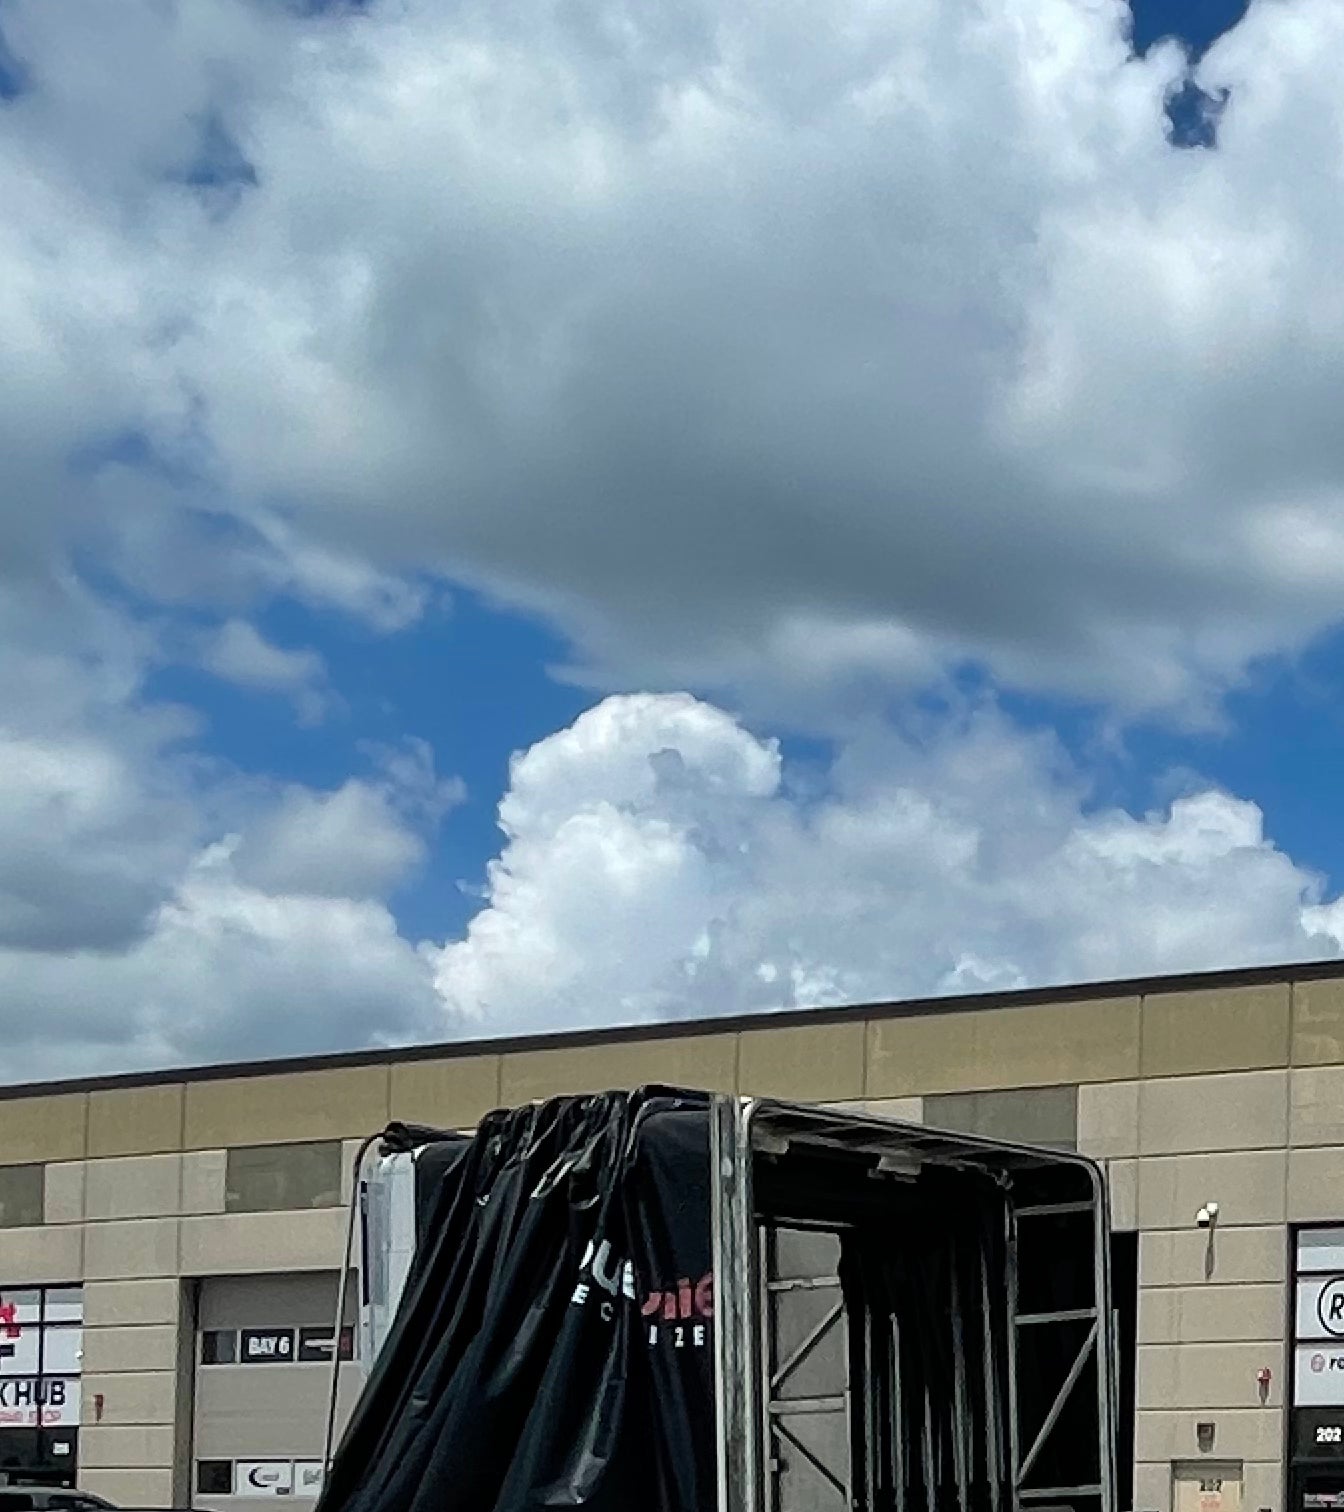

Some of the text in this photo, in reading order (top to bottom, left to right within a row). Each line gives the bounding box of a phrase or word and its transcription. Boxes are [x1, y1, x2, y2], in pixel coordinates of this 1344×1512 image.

[248, 1336, 277, 1355] BAY
[278, 1336, 290, 1354] 6
[14, 1380, 66, 1406] HUB
[1316, 1426, 1342, 1442] 202
